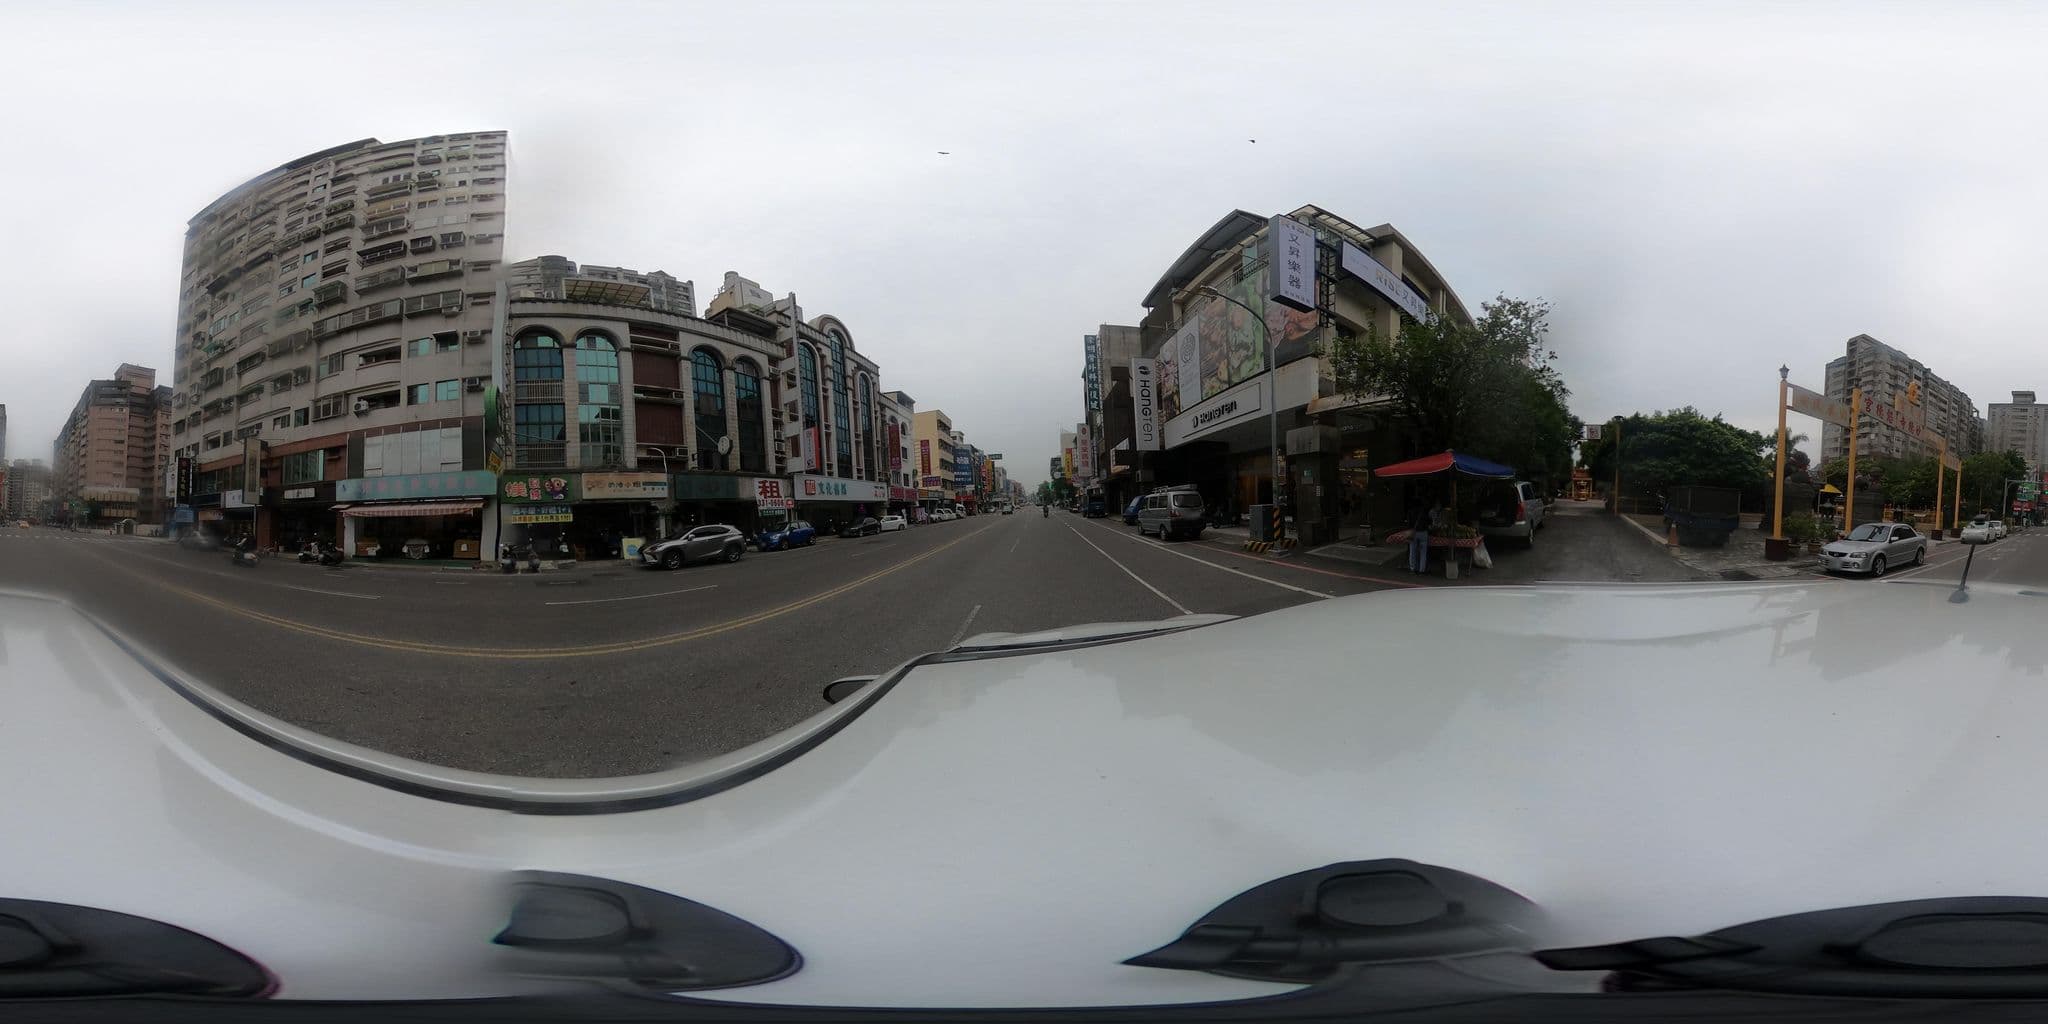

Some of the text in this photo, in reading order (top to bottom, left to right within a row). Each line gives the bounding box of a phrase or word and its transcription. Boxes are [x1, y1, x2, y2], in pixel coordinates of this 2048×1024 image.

[1288, 232, 1303, 290] 又昇樂器
[758, 480, 783, 499] 租
